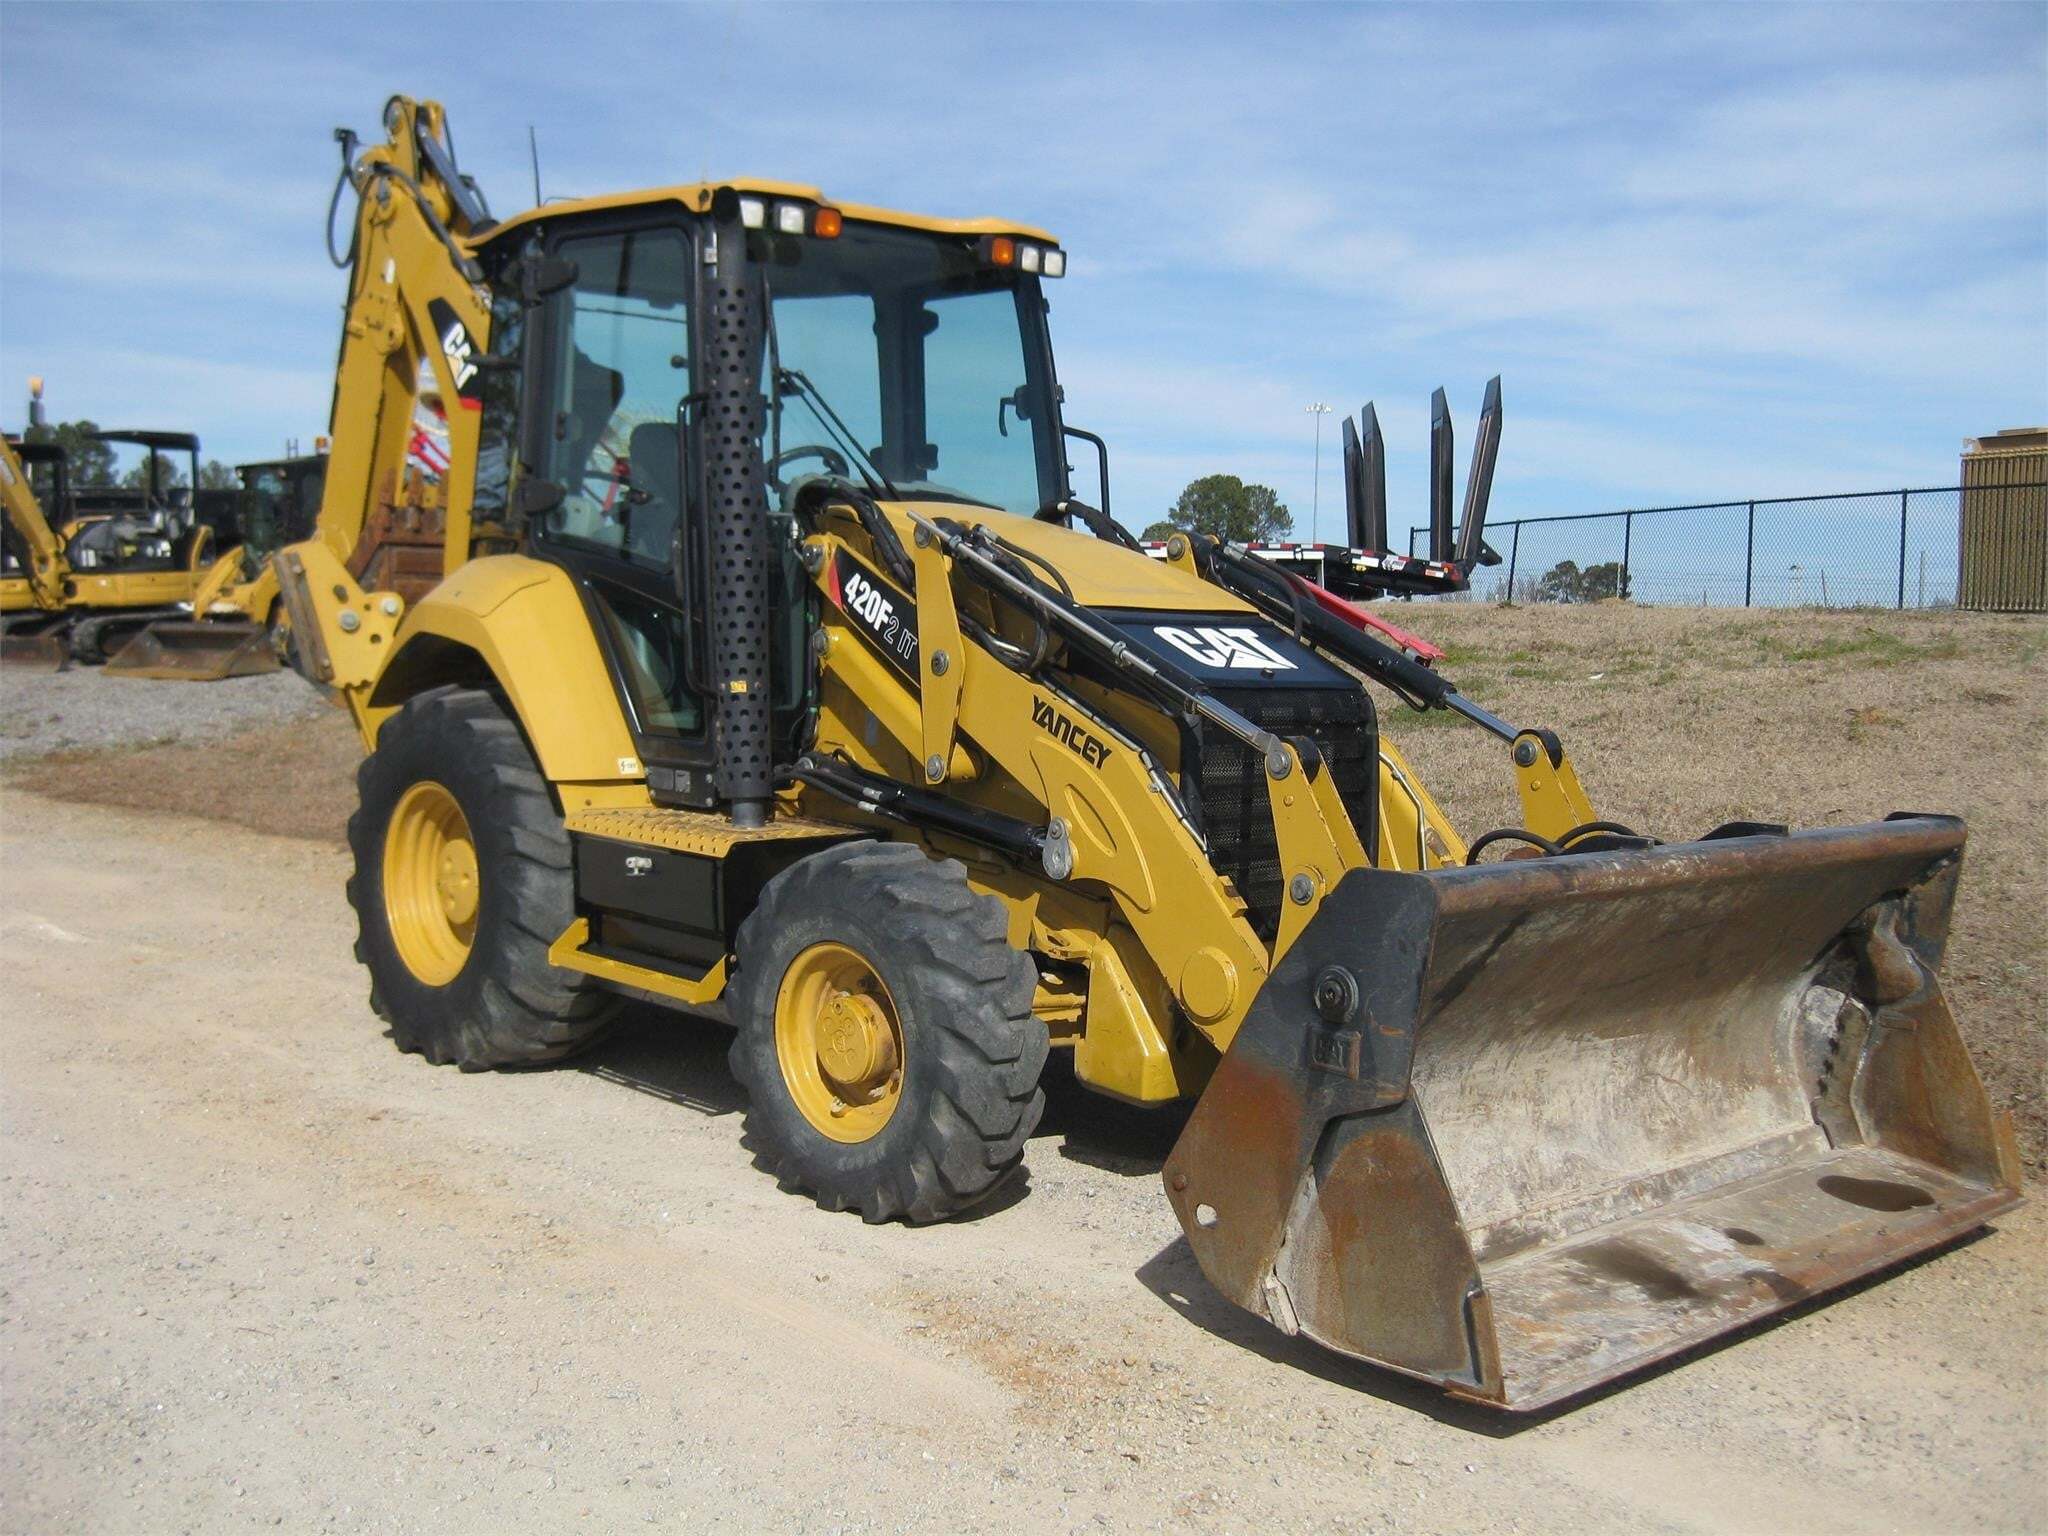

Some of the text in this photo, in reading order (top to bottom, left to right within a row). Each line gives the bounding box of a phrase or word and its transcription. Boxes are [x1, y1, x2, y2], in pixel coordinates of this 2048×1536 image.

[443, 322, 479, 390] CAT
[1153, 626, 1300, 669] CAT
[1031, 694, 1113, 770] YANCEY
